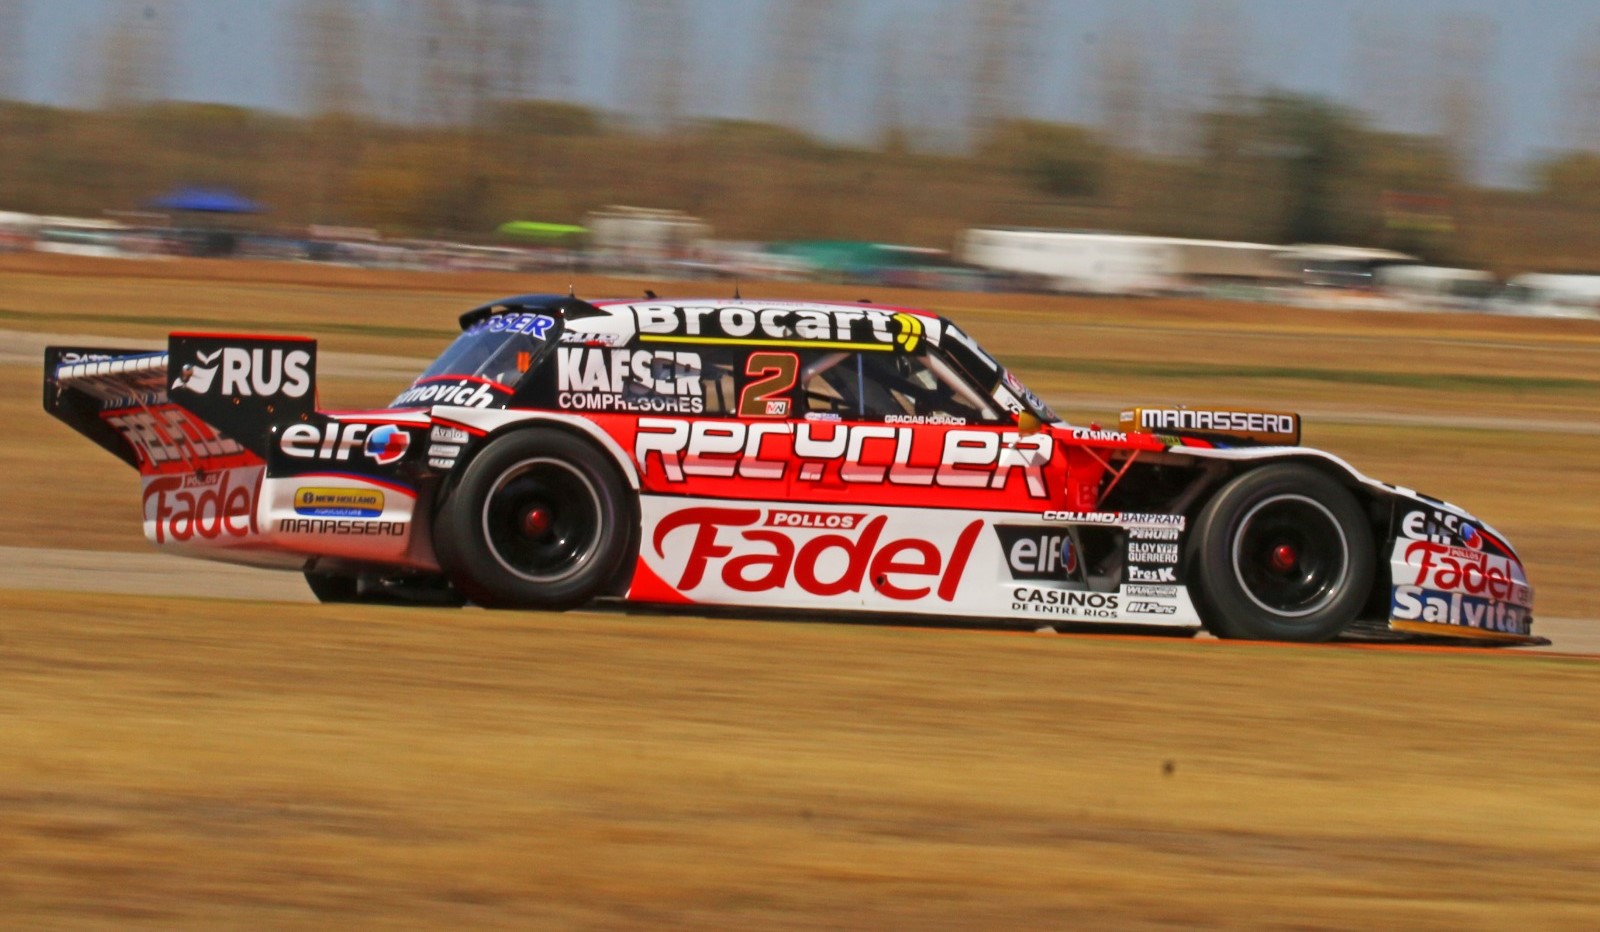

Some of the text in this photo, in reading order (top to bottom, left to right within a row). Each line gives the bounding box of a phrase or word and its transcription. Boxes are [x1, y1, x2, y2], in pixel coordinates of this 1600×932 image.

[636, 304, 895, 343] Brocart
[221, 347, 311, 398] RUS
[738, 351, 800, 418] 2
[558, 392, 704, 414] COMPRESORES
[884, 414, 967, 426] GRACIAS HORACIO
[1141, 408, 1294, 435] MANASSERO
[279, 423, 365, 460] elf
[1072, 429, 1128, 442] CASINOS
[142, 466, 267, 545] Fadel
[315, 494, 377, 505] NEW HOLLAND
[279, 518, 405, 537] MANASSERO
[773, 512, 855, 528] POLLOS
[1042, 510, 1116, 524] COLLINO
[1120, 512, 1183, 526] BARPRAN
[652, 506, 985, 602] Fadel
[1009, 535, 1062, 574] elf
[1128, 542, 1156, 553] ELOY
[1128, 551, 1178, 564] GUERRERO
[1404, 541, 1514, 602] Fadel
[1013, 587, 1119, 610] CASINOS
[1011, 602, 1118, 619] DE ENTRE RIOS
